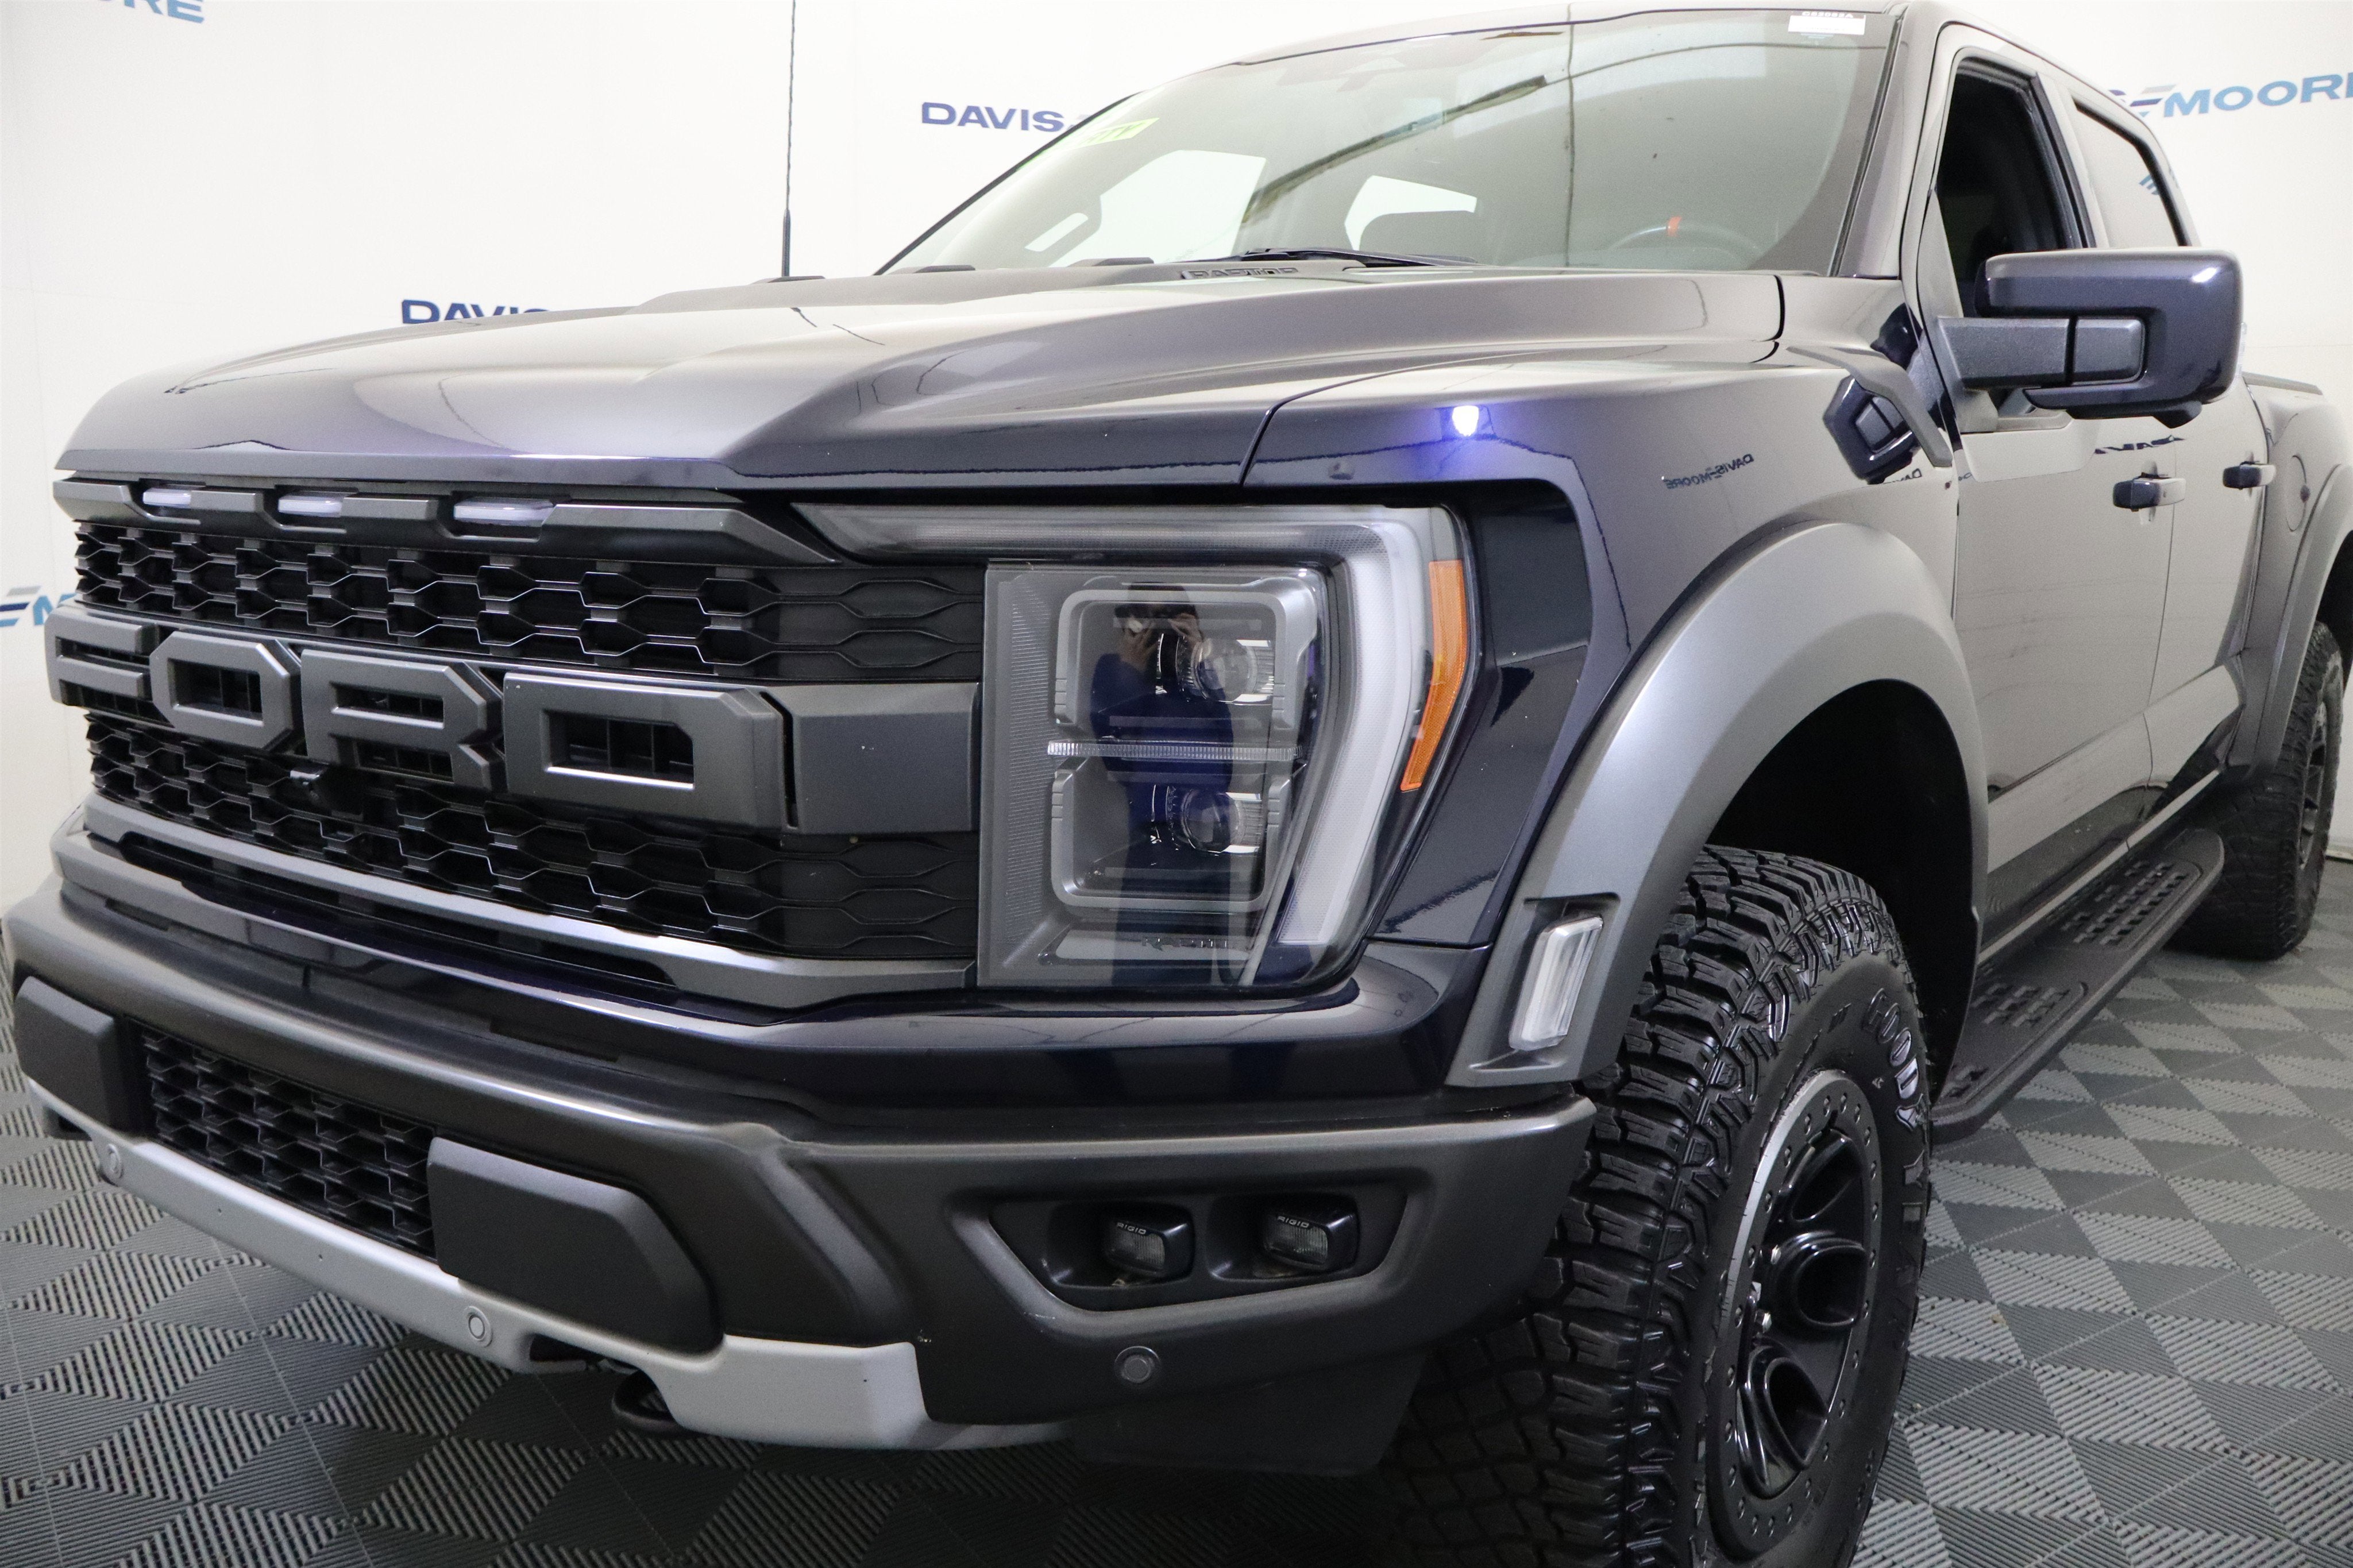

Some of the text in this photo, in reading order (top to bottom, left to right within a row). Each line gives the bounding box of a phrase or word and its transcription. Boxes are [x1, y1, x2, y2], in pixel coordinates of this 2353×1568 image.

[2163, 72, 2353, 118] MOOR
[921, 102, 1064, 133] DAVIS
[44, 606, 782, 834] FORD
[1116, 1222, 1147, 1235] RIGID
[1277, 1215, 1310, 1229] RIGID
